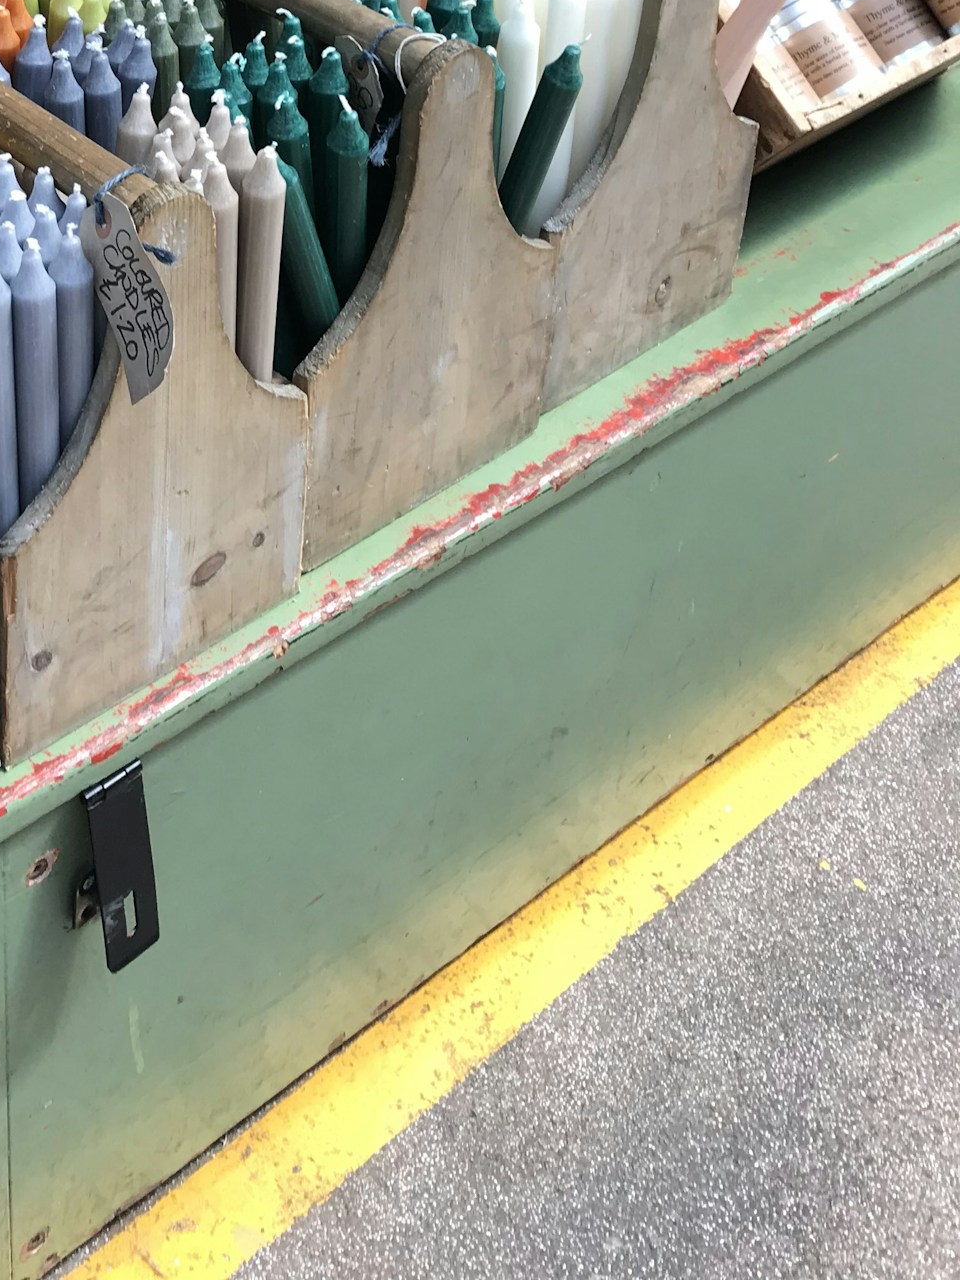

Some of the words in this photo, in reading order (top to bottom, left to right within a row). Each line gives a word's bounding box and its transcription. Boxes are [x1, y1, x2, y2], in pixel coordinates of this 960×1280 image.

[863, 3, 895, 23] Thyme
[792, 41, 822, 63] Thyme
[115, 228, 171, 351] COLOURED
